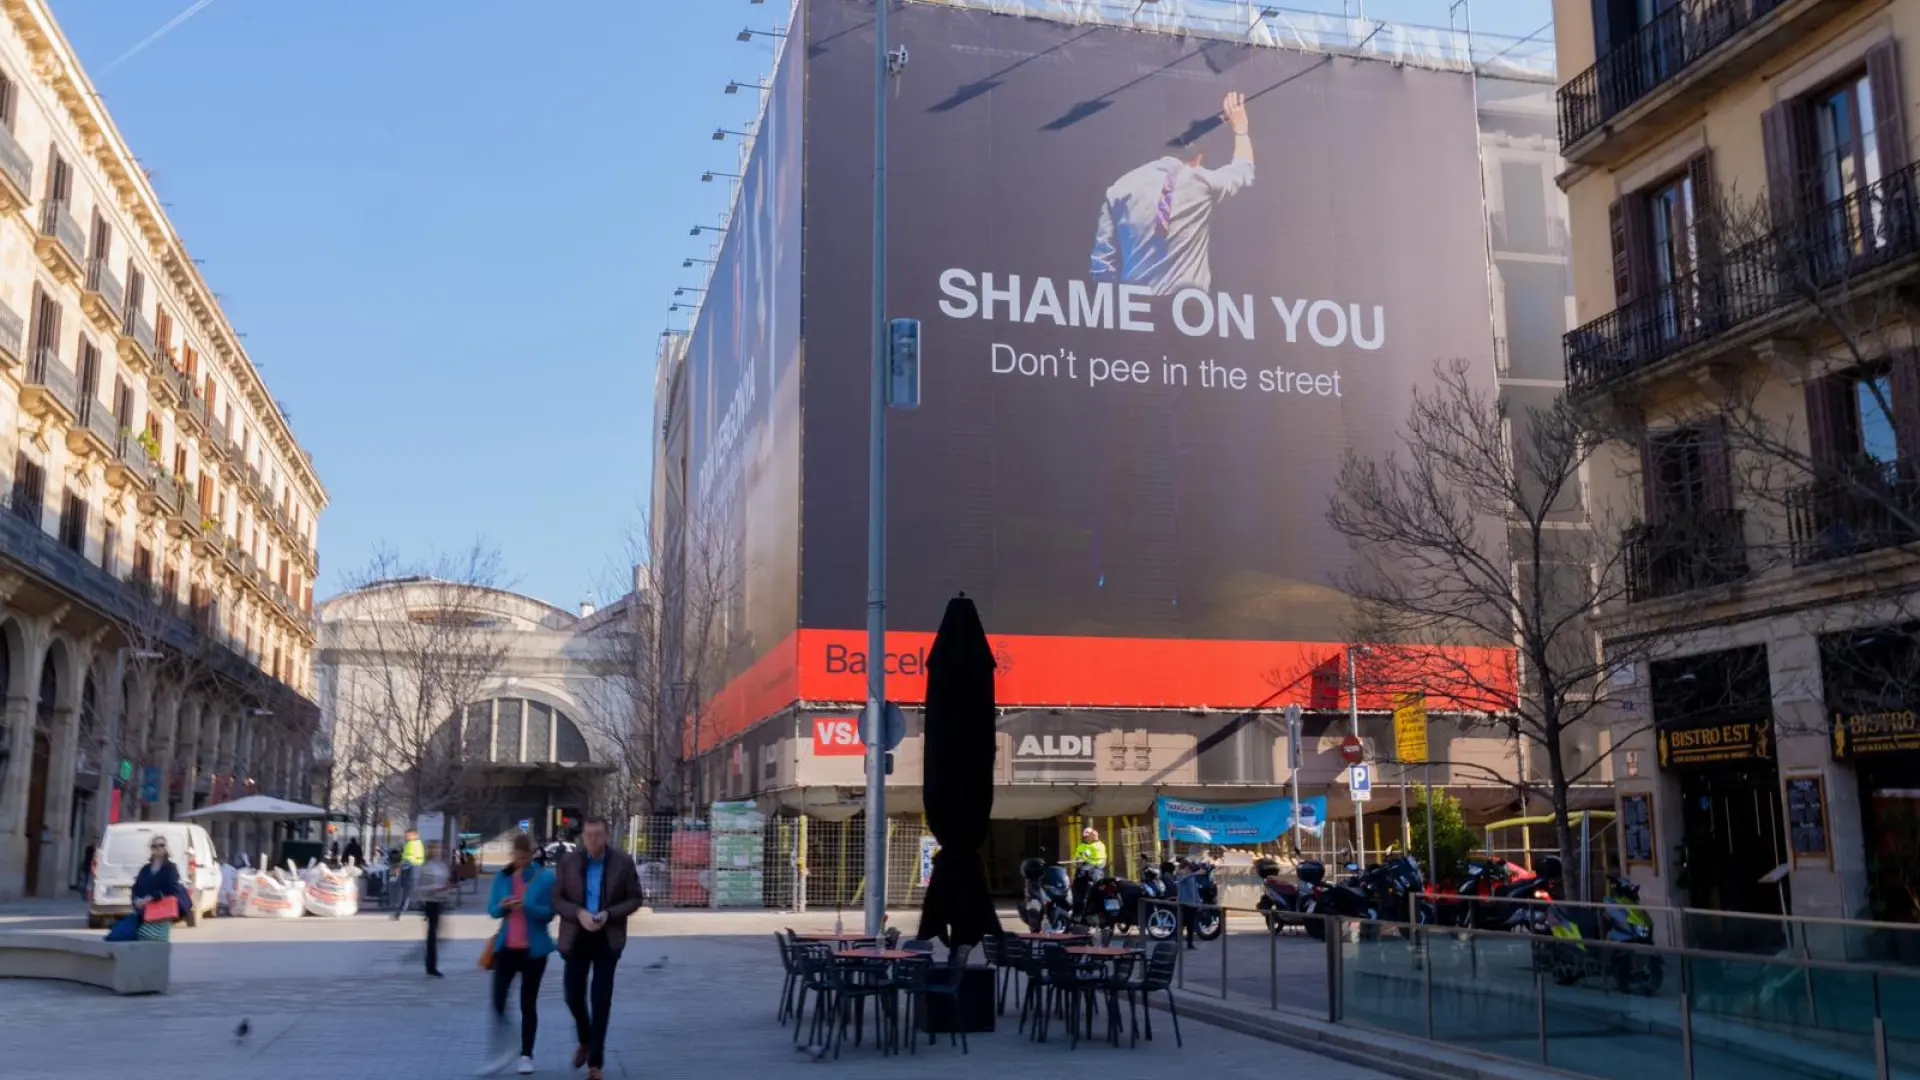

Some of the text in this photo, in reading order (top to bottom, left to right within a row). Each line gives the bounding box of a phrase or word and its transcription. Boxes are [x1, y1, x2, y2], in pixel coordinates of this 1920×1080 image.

[938, 267, 1386, 350] SHAME ON YOU
[990, 342, 1343, 398] Don't pee in the street
[816, 721, 862, 745] VS
[1671, 723, 1751, 748] BISTRO EST
[1017, 734, 1093, 757] ALDI
[1353, 767, 1367, 789] P
